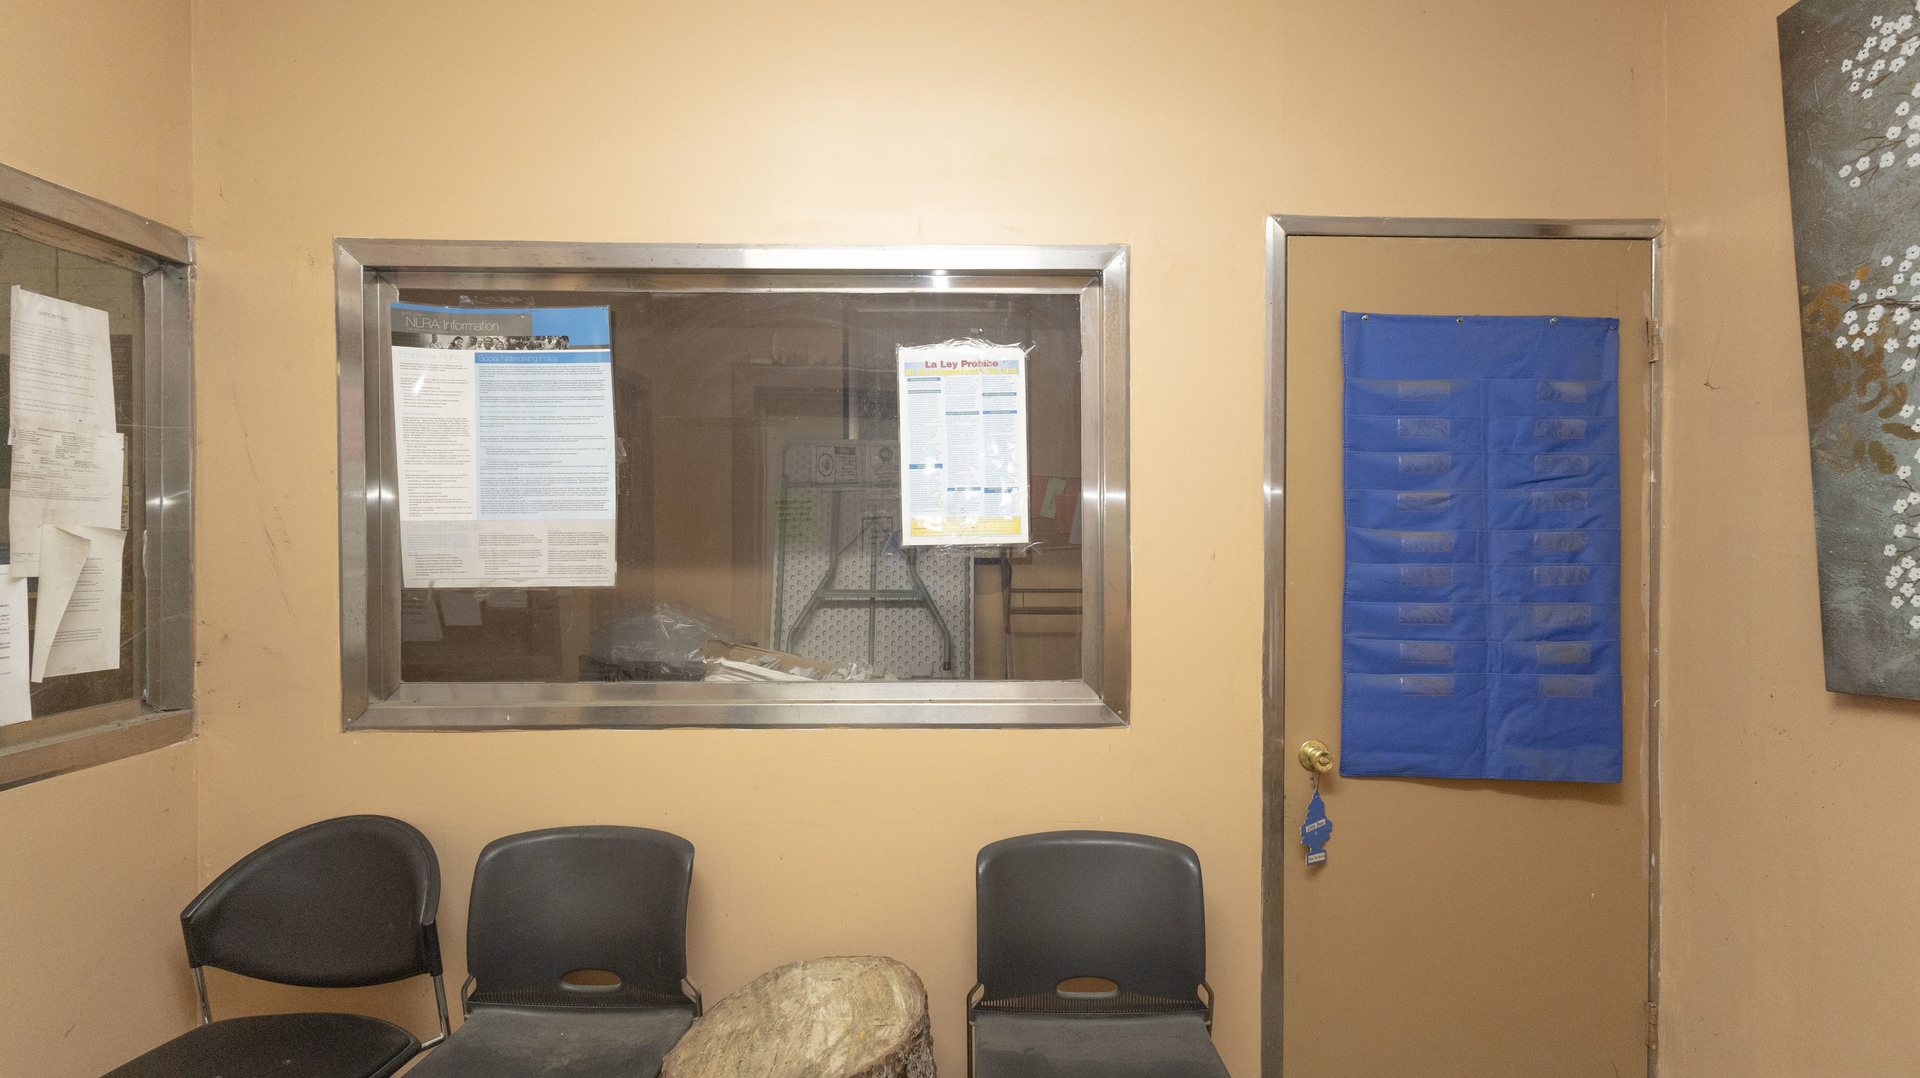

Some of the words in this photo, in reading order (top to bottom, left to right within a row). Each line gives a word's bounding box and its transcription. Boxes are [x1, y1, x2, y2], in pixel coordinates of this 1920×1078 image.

[405, 316, 440, 329] NLRA
[443, 319, 499, 331] Information
[478, 354, 498, 362] Social
[500, 354, 537, 363] Networking
[539, 354, 558, 363] Policy
[925, 360, 937, 368] La
[940, 360, 958, 369] Ley
[918, 367, 984, 377] Hostigamiento
[986, 367, 1017, 375] Sexual
